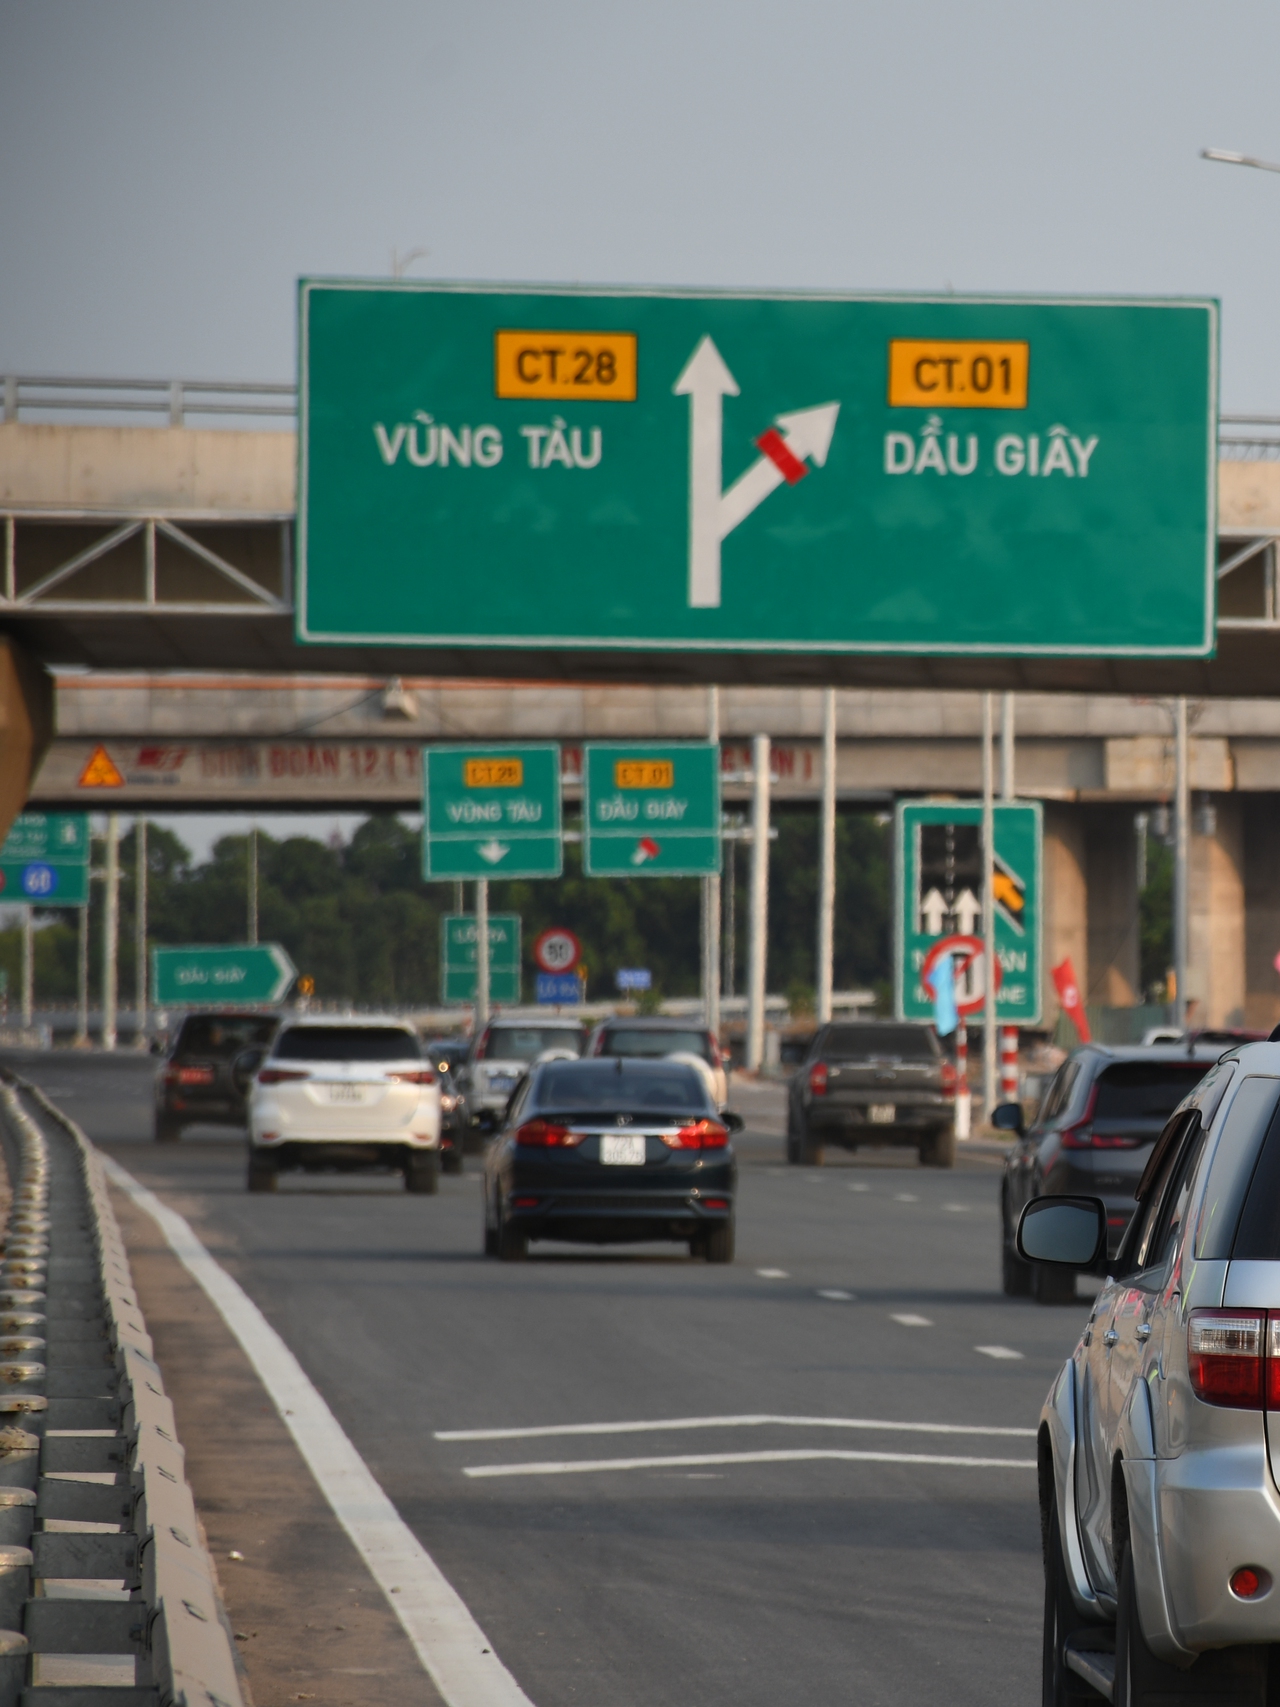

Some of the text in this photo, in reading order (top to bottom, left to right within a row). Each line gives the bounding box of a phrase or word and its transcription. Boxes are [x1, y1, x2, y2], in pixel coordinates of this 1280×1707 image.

[516, 347, 617, 386] CT.28
[914, 355, 1012, 396] CT.01
[373, 409, 602, 469] VŨNG TÀU
[884, 413, 1099, 478] DẦU GIÂY
